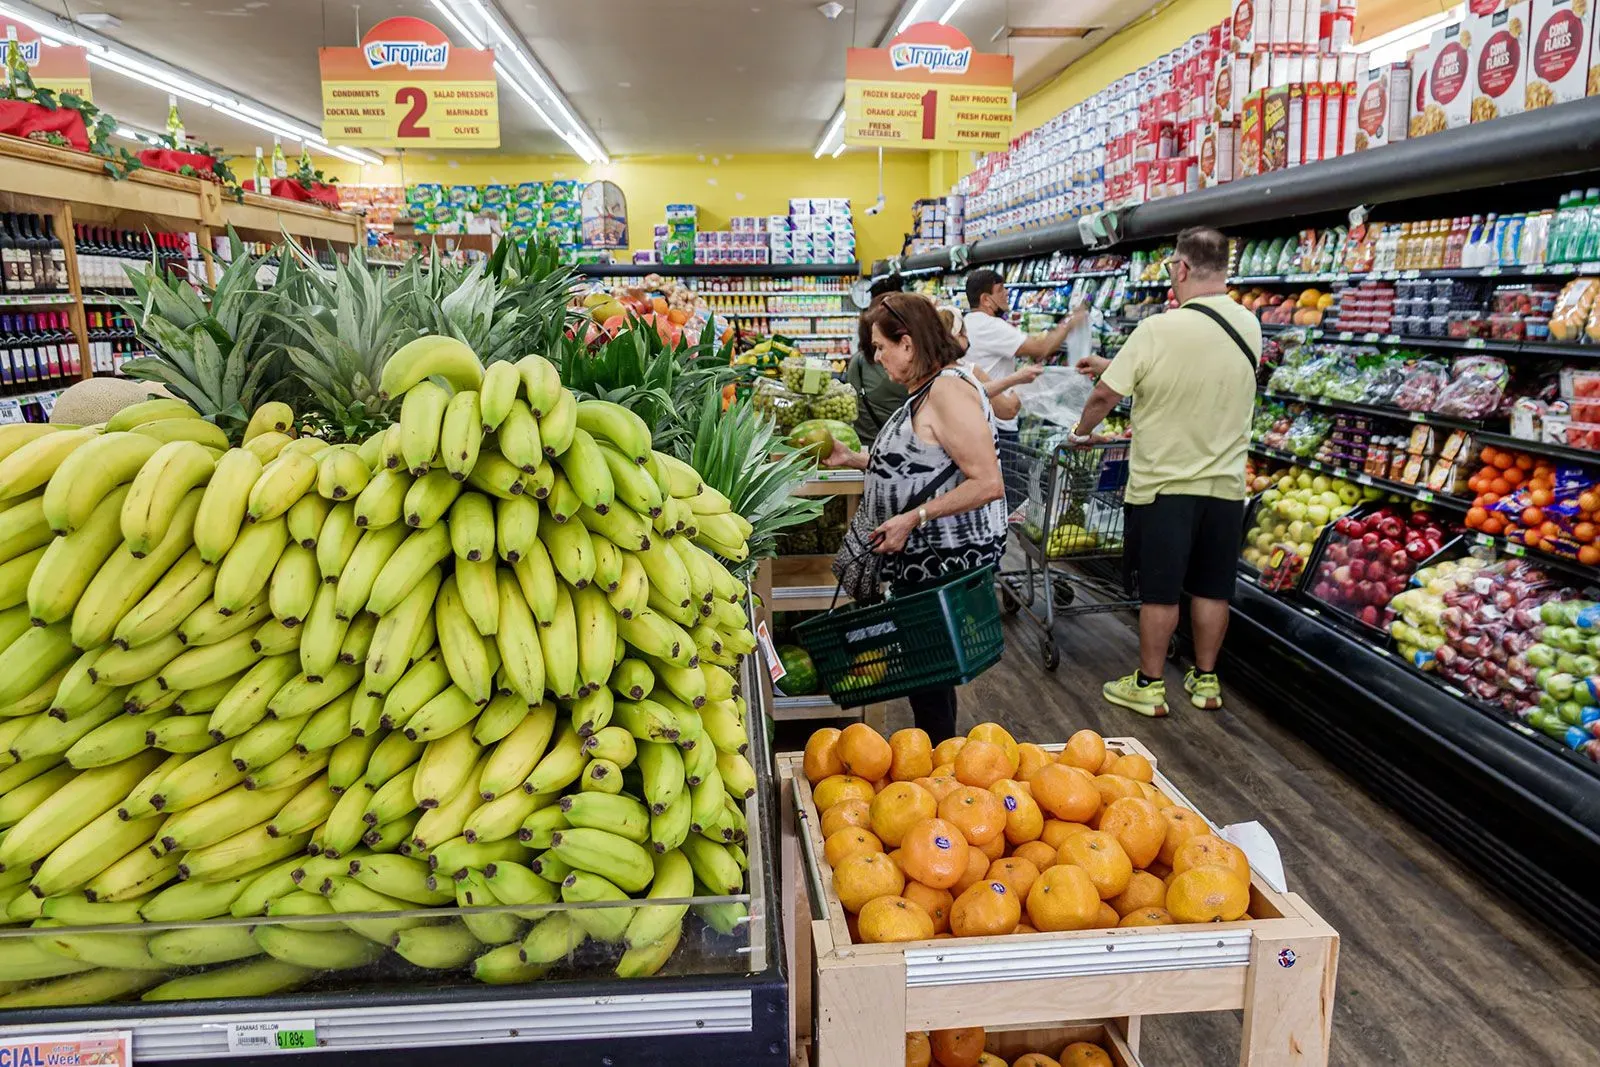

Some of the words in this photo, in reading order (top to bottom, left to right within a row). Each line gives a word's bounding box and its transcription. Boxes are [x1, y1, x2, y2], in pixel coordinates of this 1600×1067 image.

[1549, 20, 1569, 37] CORN
[1544, 33, 1572, 52] FLAKES
[383, 44, 446, 66] Tropical
[909, 47, 969, 69] Tropical
[1486, 52, 1510, 70] FLAKES
[863, 90, 889, 98] FROZEN
[890, 91, 921, 100] SEAFOOD
[950, 94, 970, 102] DAIRY
[972, 95, 1008, 104] PRODUCTS
[326, 108, 360, 116] COCKTAIL
[362, 108, 386, 116] MIXES
[395, 87, 430, 138] 2
[866, 108, 895, 116] ORANGE
[897, 109, 917, 117] JUICE
[921, 90, 938, 139] 1
[957, 112, 979, 120] FRESH
[981, 113, 1013, 122] FLOWERS
[344, 126, 363, 134] WINE
[454, 126, 480, 134] OLIVES
[858, 129, 901, 137] VEGETABLES
[957, 130, 980, 138] FRESH
[981, 131, 1001, 139] FRUIT
[259, 1023, 279, 1031] YELLOW
[0, 1046, 45, 1067] CIAL
[47, 1053, 80, 1066] Week
